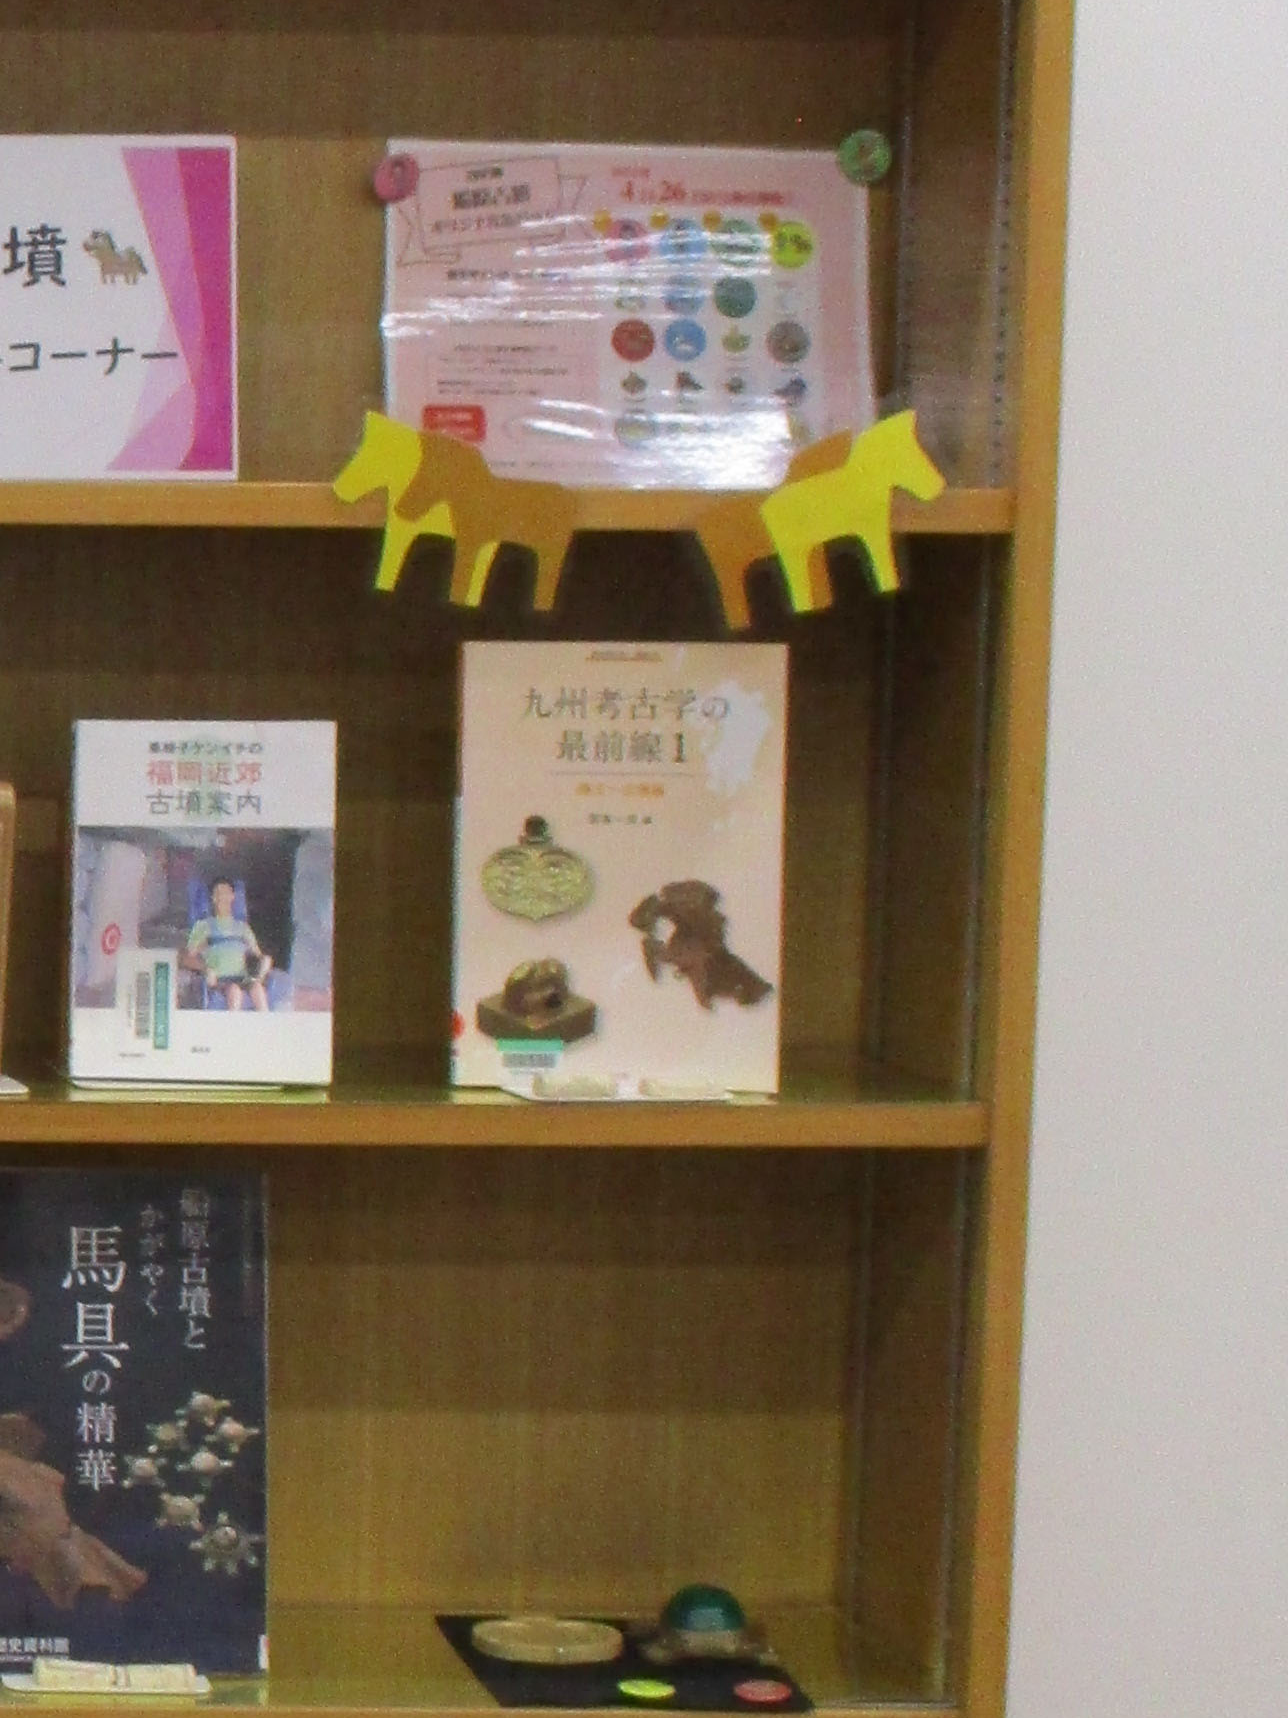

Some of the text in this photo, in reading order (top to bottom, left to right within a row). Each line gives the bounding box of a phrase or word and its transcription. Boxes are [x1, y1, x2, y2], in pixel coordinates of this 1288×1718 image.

[525, 687, 731, 722] 九州考古学の
[145, 790, 262, 816] 古墳案内
[60, 1225, 130, 1492] 馬具の精華
